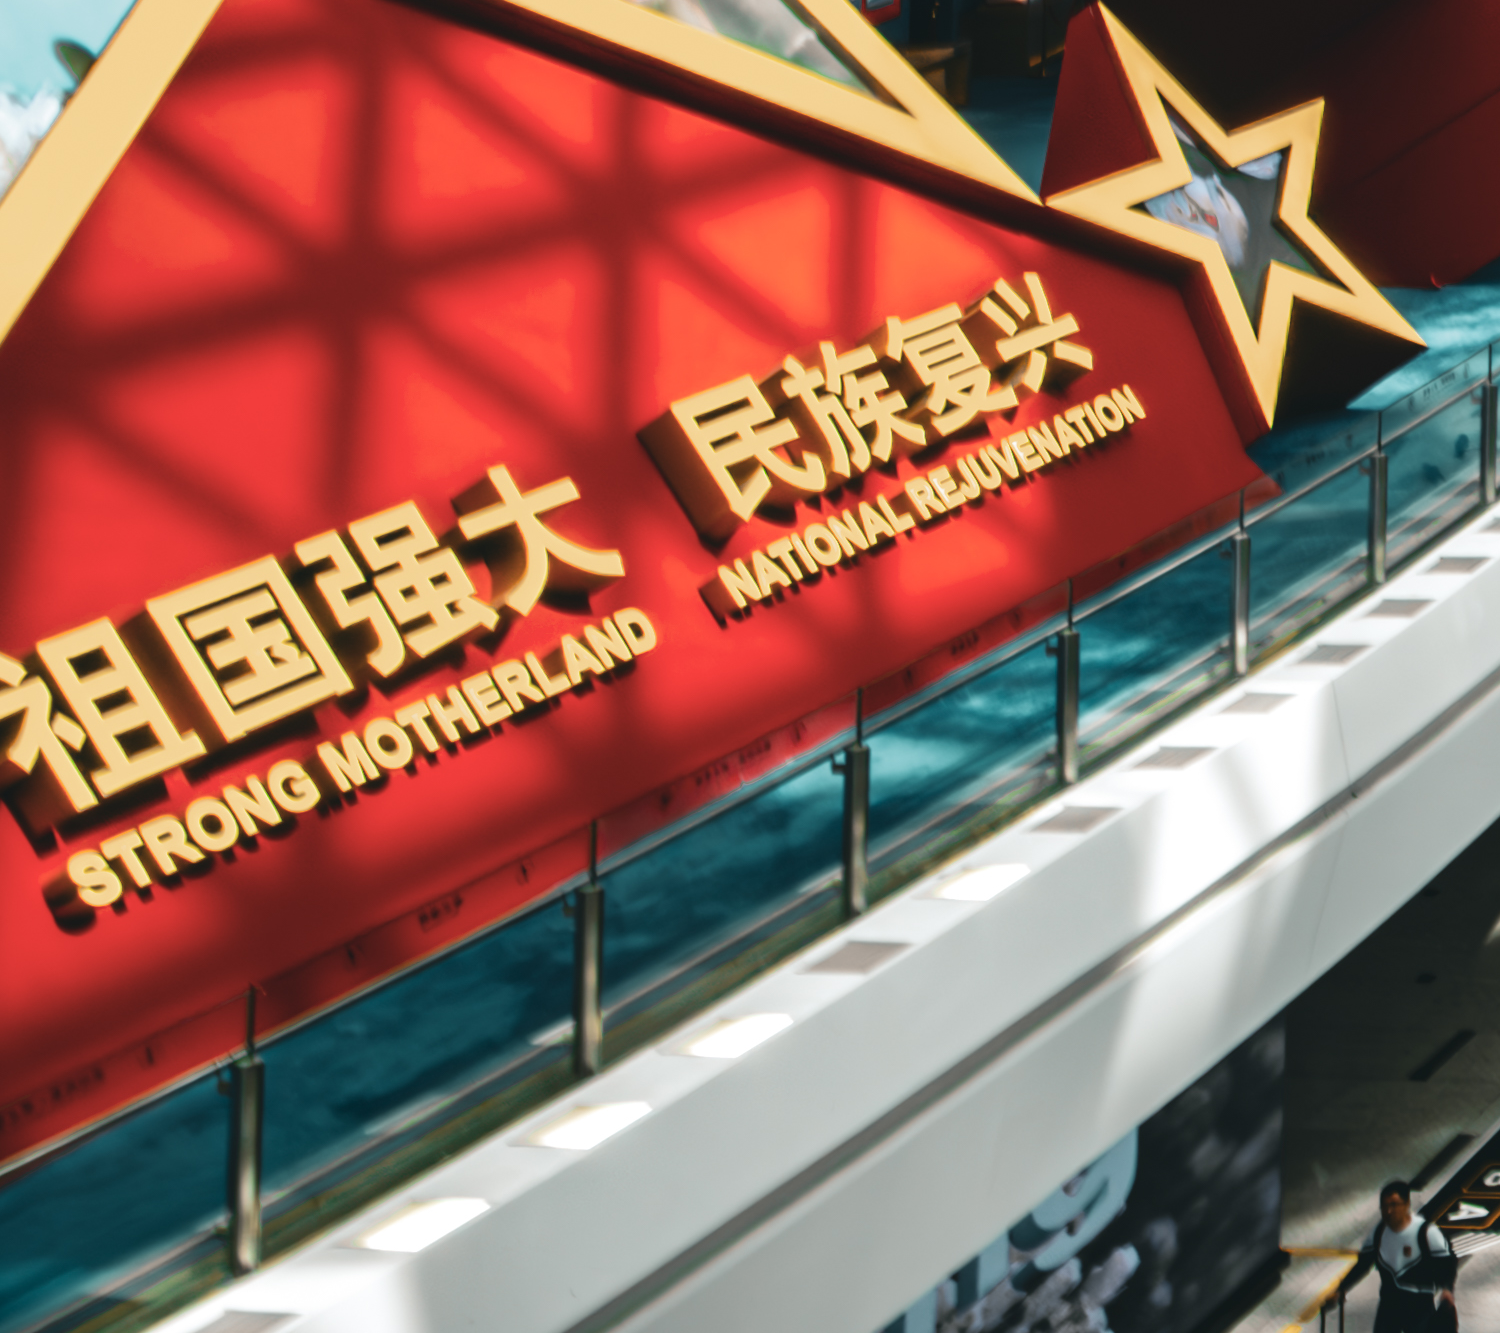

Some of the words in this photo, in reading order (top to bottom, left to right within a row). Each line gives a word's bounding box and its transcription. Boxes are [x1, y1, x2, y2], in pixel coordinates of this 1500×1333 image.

[670, 271, 1093, 522] 民族复兴
[717, 493, 916, 608] NATIONAL
[904, 384, 1147, 521] REJUVENATION
[0, 464, 626, 813] 祖国强大
[67, 759, 322, 908] STRONG
[317, 606, 659, 794] MOTHERLAND
[1447, 1200, 1490, 1222] A
